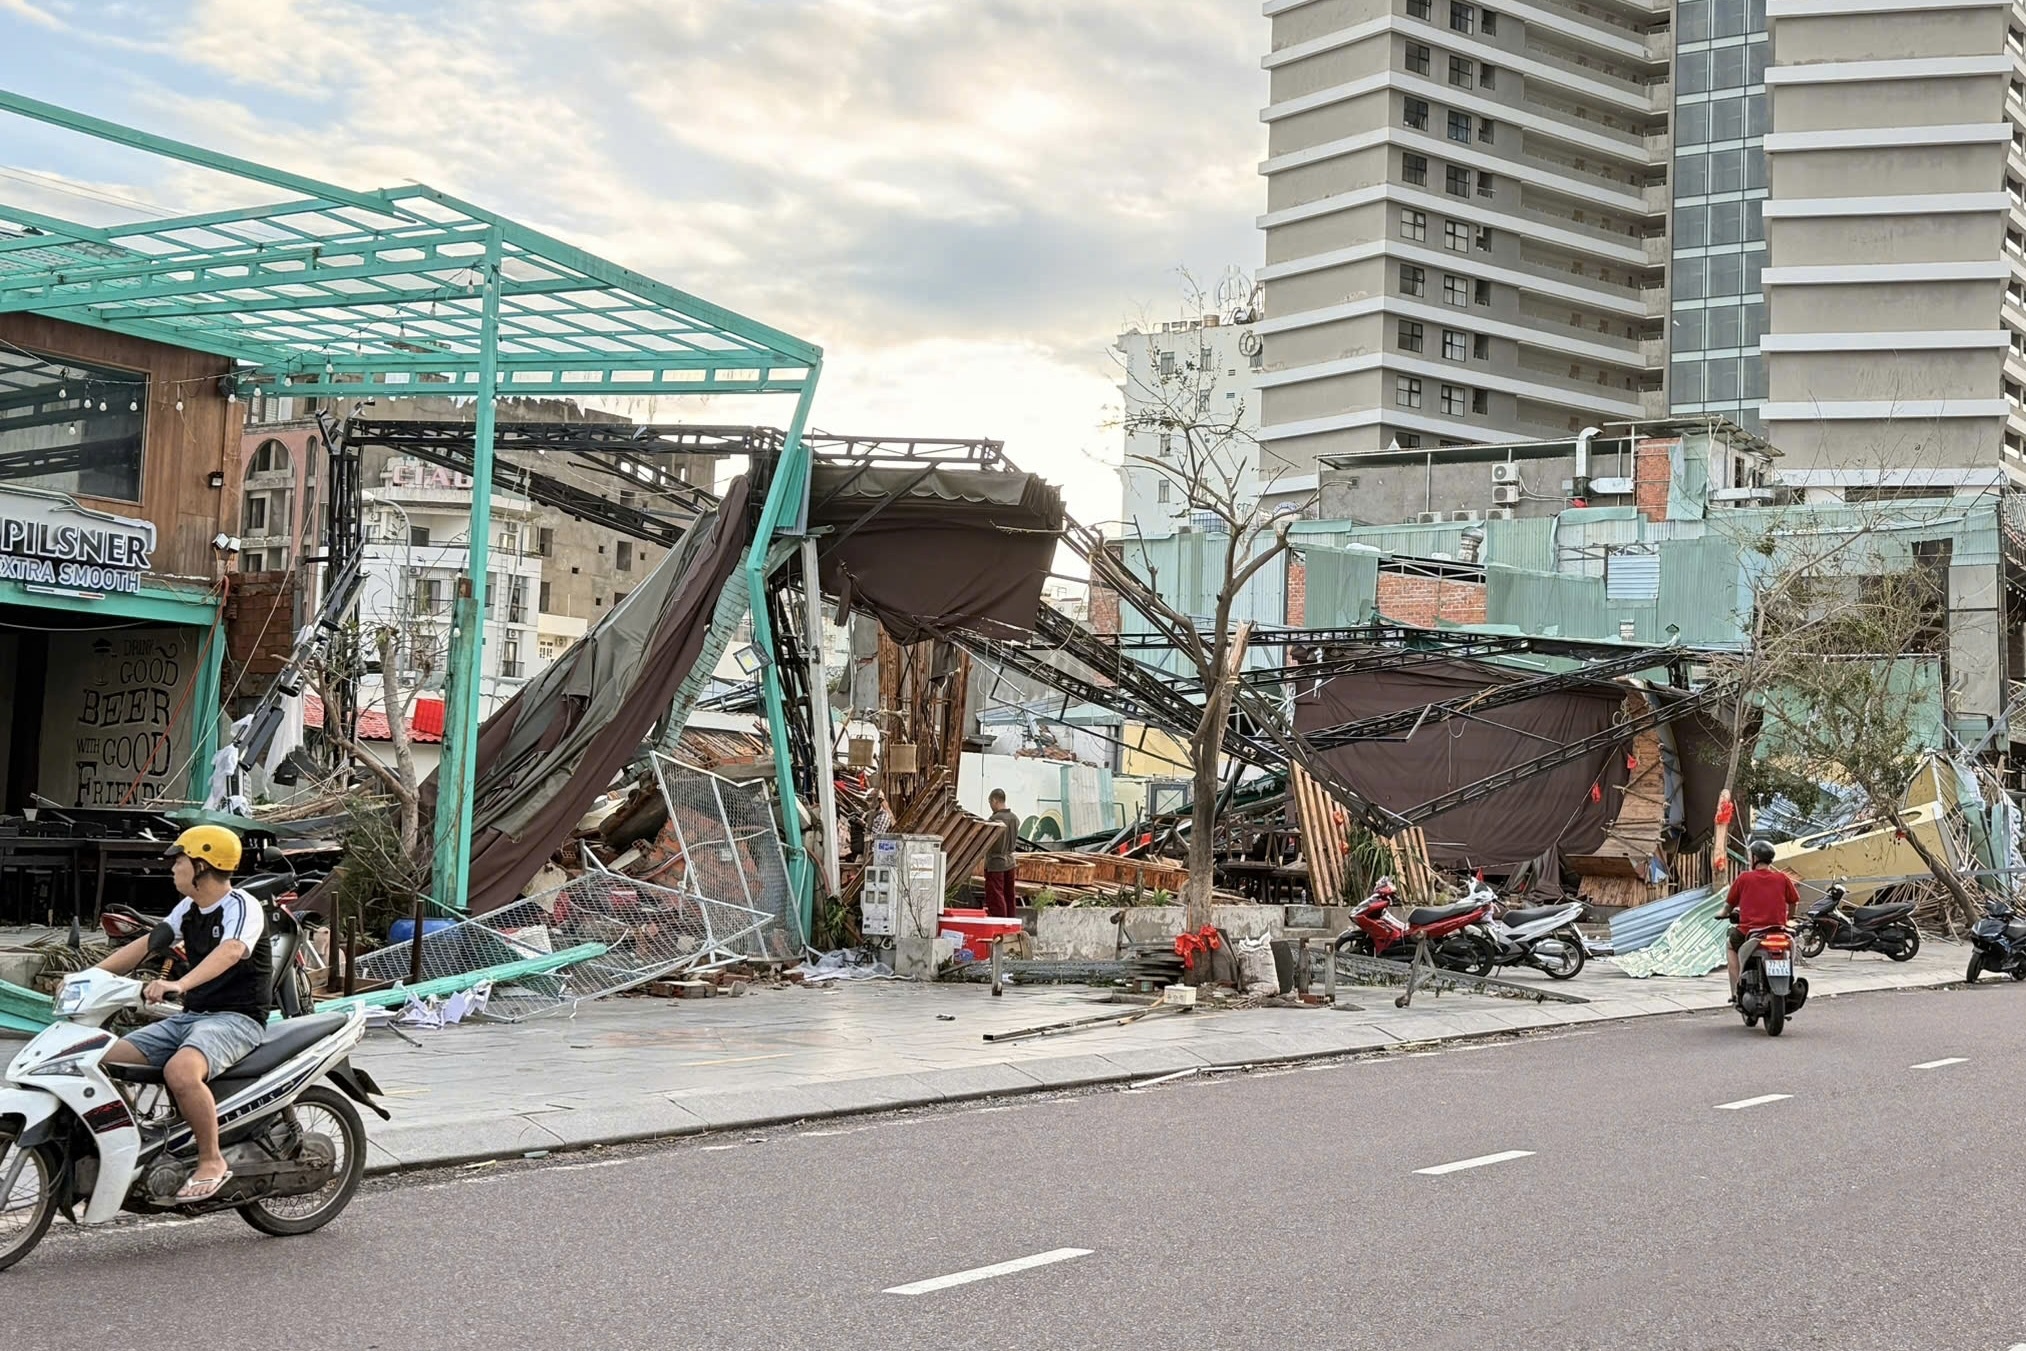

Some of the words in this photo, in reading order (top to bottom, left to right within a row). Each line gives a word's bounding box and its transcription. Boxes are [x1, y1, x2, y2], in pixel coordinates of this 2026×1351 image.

[2, 518, 151, 568] PILSNER
[58, 562, 140, 593] SMOOTH
[119, 658, 179, 687] GOOD
[77, 688, 171, 728] BEER
[76, 738, 101, 754] WITH
[103, 732, 172, 777] GOOD
[74, 761, 166, 808] FRIENDS
[225, 1093, 275, 1122] IRIUS
